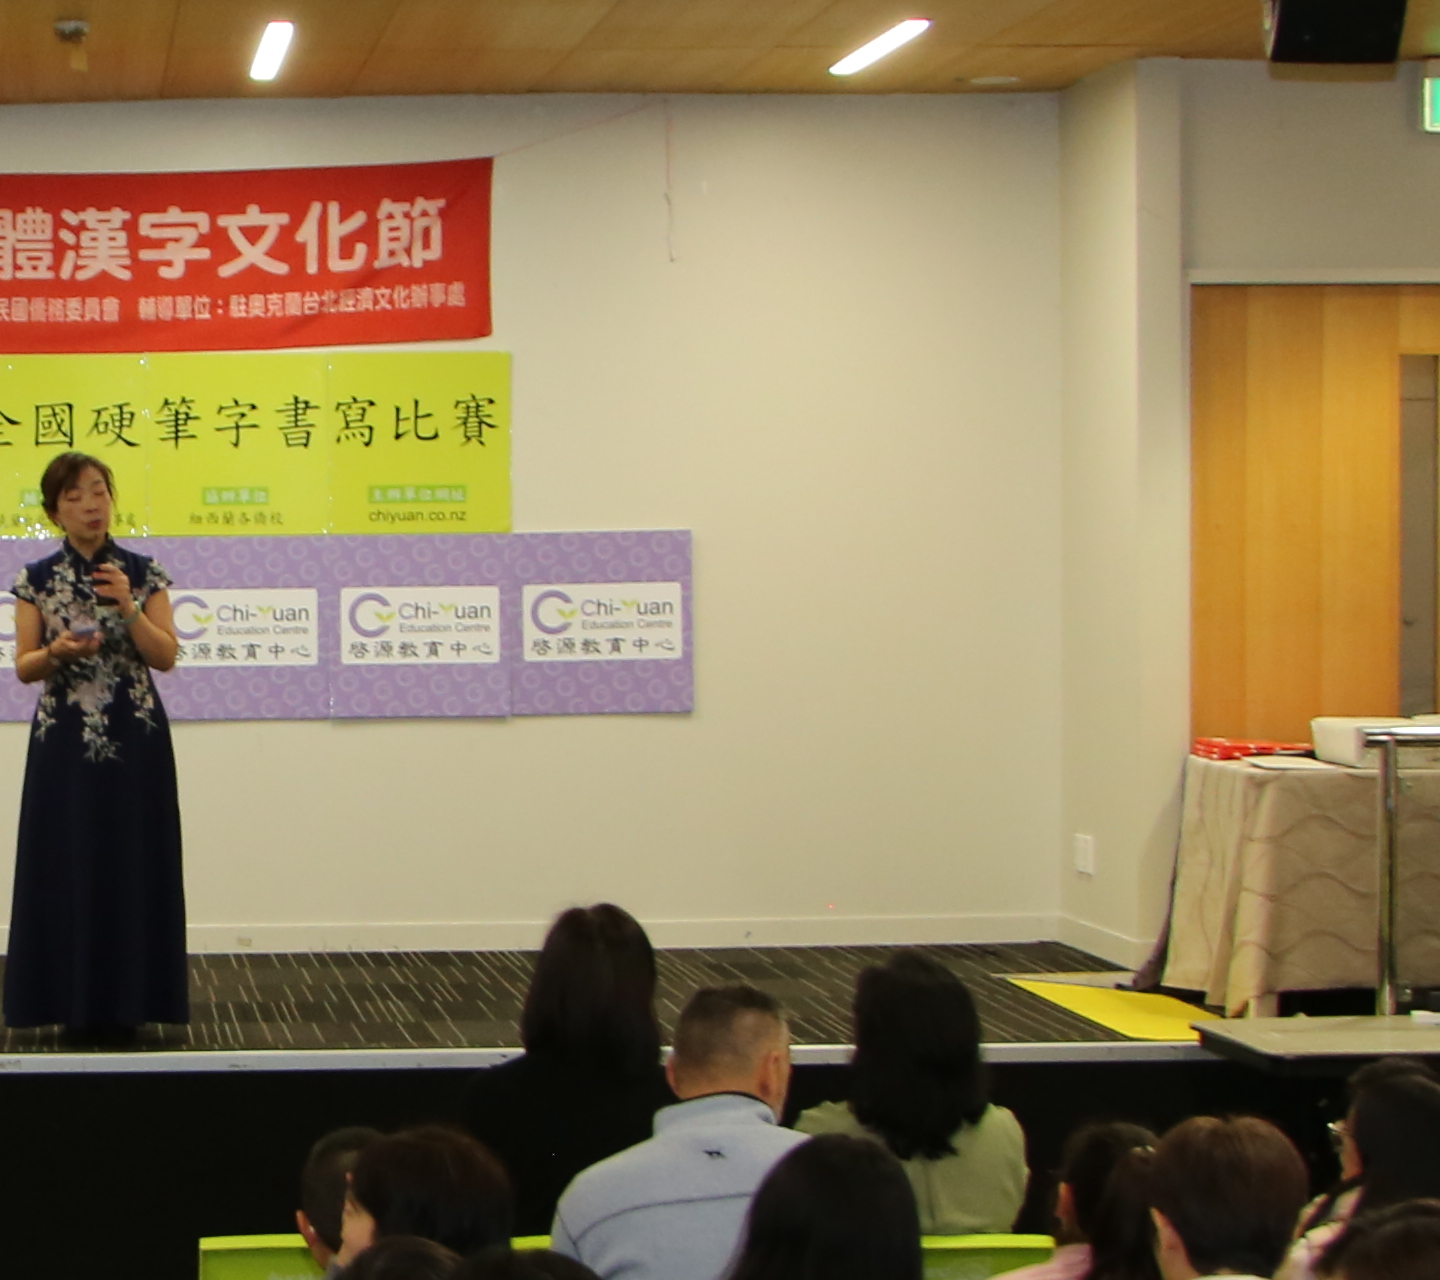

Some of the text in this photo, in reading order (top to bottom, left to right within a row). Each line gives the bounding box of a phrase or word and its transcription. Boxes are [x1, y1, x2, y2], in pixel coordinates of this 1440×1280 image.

[369, 509, 466, 524] chiyuan.co.nz
[217, 625, 309, 635] Education Centre
[399, 622, 491, 633] Education Centre
[581, 619, 673, 630] Education Centre
